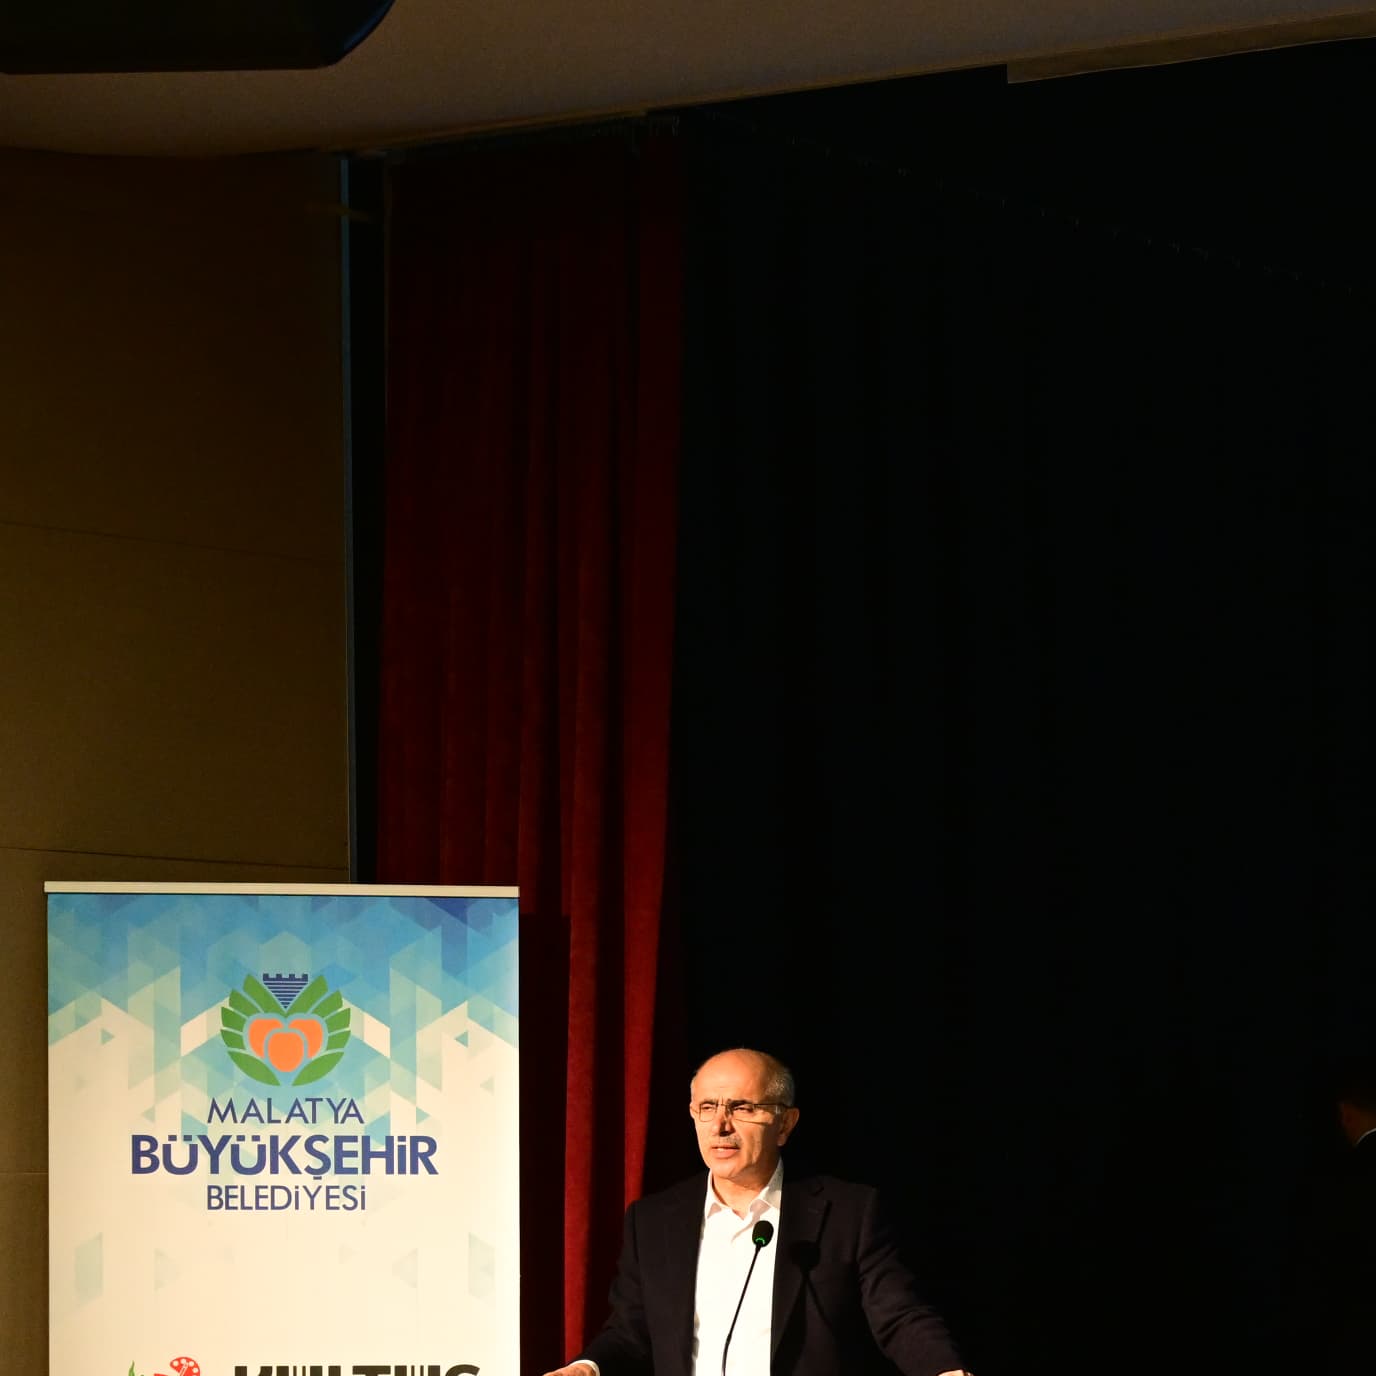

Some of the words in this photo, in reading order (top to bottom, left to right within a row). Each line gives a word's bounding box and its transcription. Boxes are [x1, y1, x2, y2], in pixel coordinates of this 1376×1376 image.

[206, 1096, 366, 1125] MALATYA
[130, 1133, 440, 1181] BÜYÜKŞEHİR
[206, 1184, 367, 1212] BELEDİYESİ
